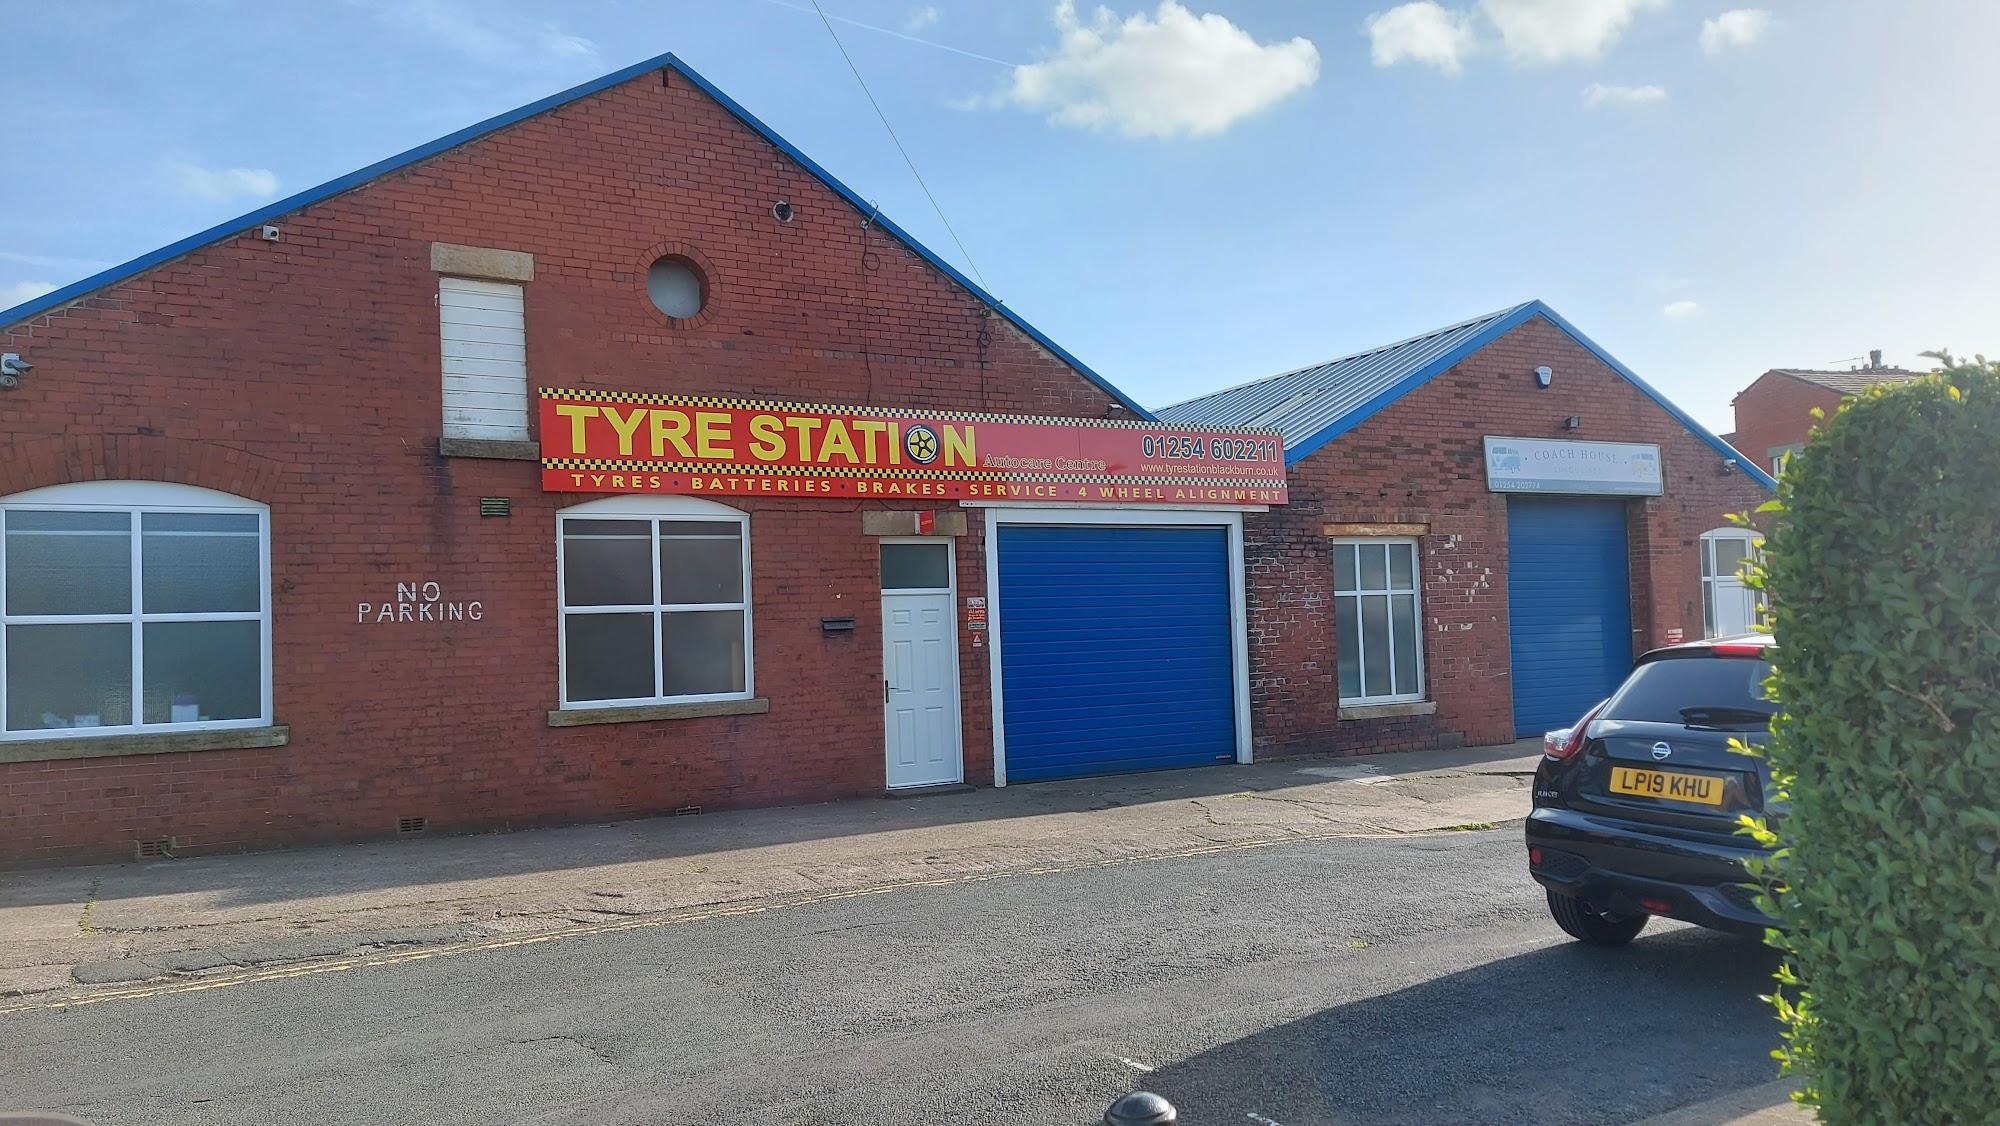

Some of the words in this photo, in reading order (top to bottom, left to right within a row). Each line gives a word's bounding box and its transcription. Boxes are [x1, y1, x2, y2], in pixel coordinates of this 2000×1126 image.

[556, 404, 735, 460] TYRE
[1142, 434, 1205, 459] 01254
[1210, 437, 1278, 463] 602211
[1534, 449, 1575, 461] COACH
[1581, 450, 1618, 464] HOUSE
[983, 453, 1052, 469] Autocare
[1055, 456, 1107, 471] Centre
[1140, 462, 1279, 476] www.tyrestationblackburn.co.uk
[571, 474, 662, 489] TYRES
[691, 477, 832, 493] BATTERIES
[857, 481, 946, 495] BRAKES
[969, 484, 1058, 497] SERVICE
[1078, 487, 1088, 498] 4
[1099, 487, 1165, 499] WHEEL
[1175, 488, 1281, 500] ALIGNMENT
[1494, 480, 1515, 489] 01254
[397, 581, 441, 602] NO
[358, 601, 483, 623] PARKING
[1535, 790, 1558, 799] JUKE
[1622, 770, 1665, 793] LP19
[1669, 777, 1711, 798] KHU
